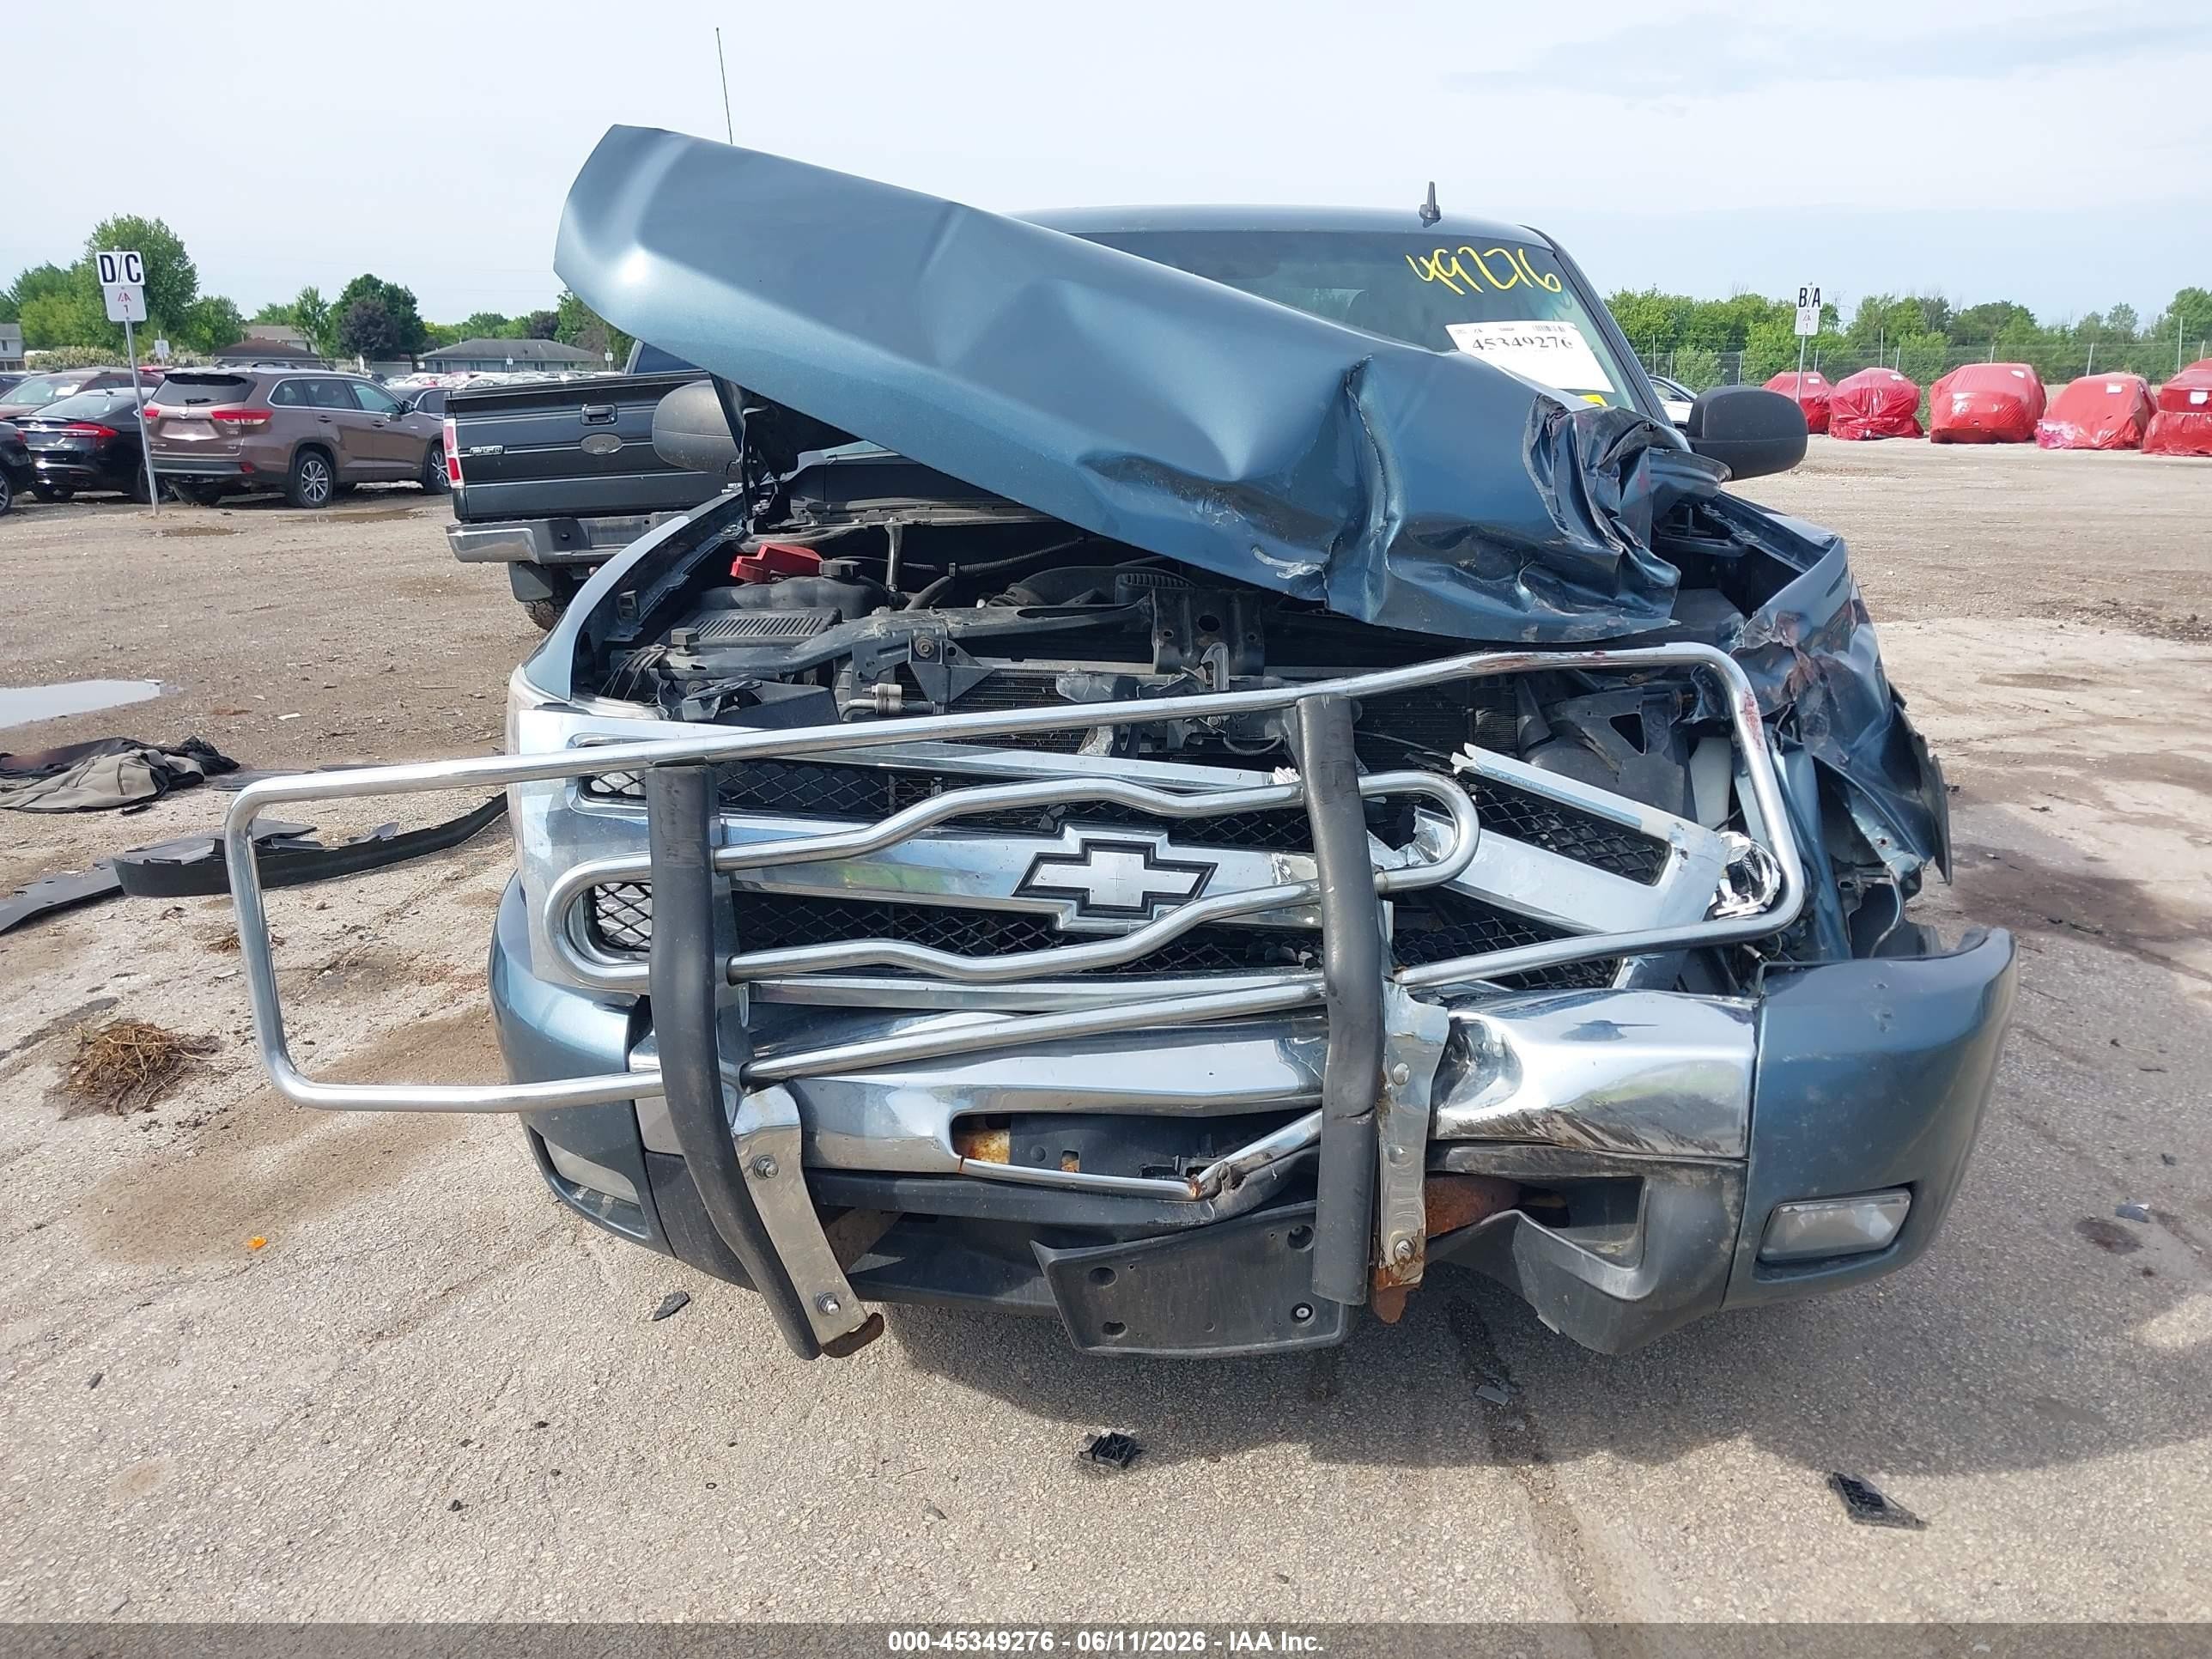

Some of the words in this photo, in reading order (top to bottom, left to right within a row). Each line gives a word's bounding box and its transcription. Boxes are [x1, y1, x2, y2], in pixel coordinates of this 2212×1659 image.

[99, 253, 142, 283] D/C
[1405, 246, 1562, 295] 49276
[1798, 287, 1821, 308] B/A
